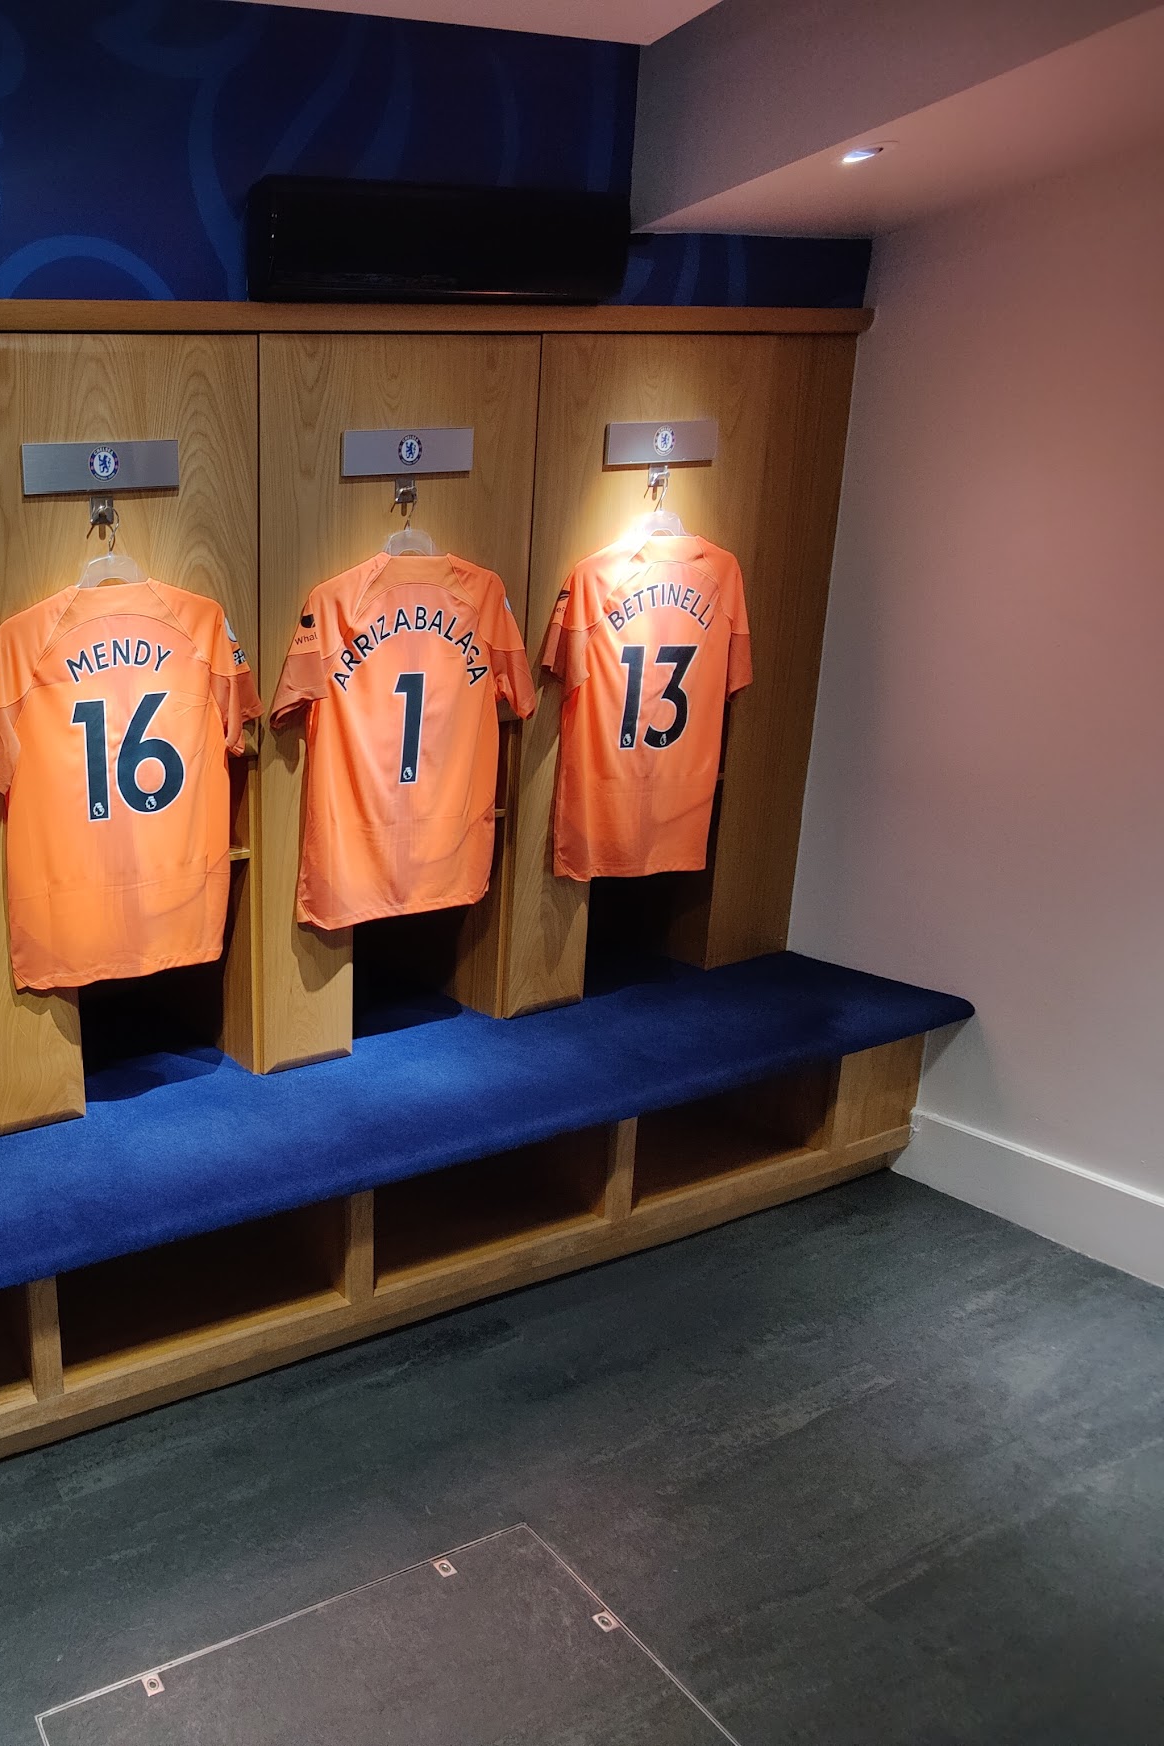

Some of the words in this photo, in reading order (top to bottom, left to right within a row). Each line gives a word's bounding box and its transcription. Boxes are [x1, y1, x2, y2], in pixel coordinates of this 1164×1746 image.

[65, 637, 173, 684] MENDY
[295, 631, 319, 645] Whal
[332, 605, 490, 692] ARRIZABALAGA
[394, 672, 426, 785] 1
[618, 644, 699, 750] 13
[70, 690, 186, 822] 16
